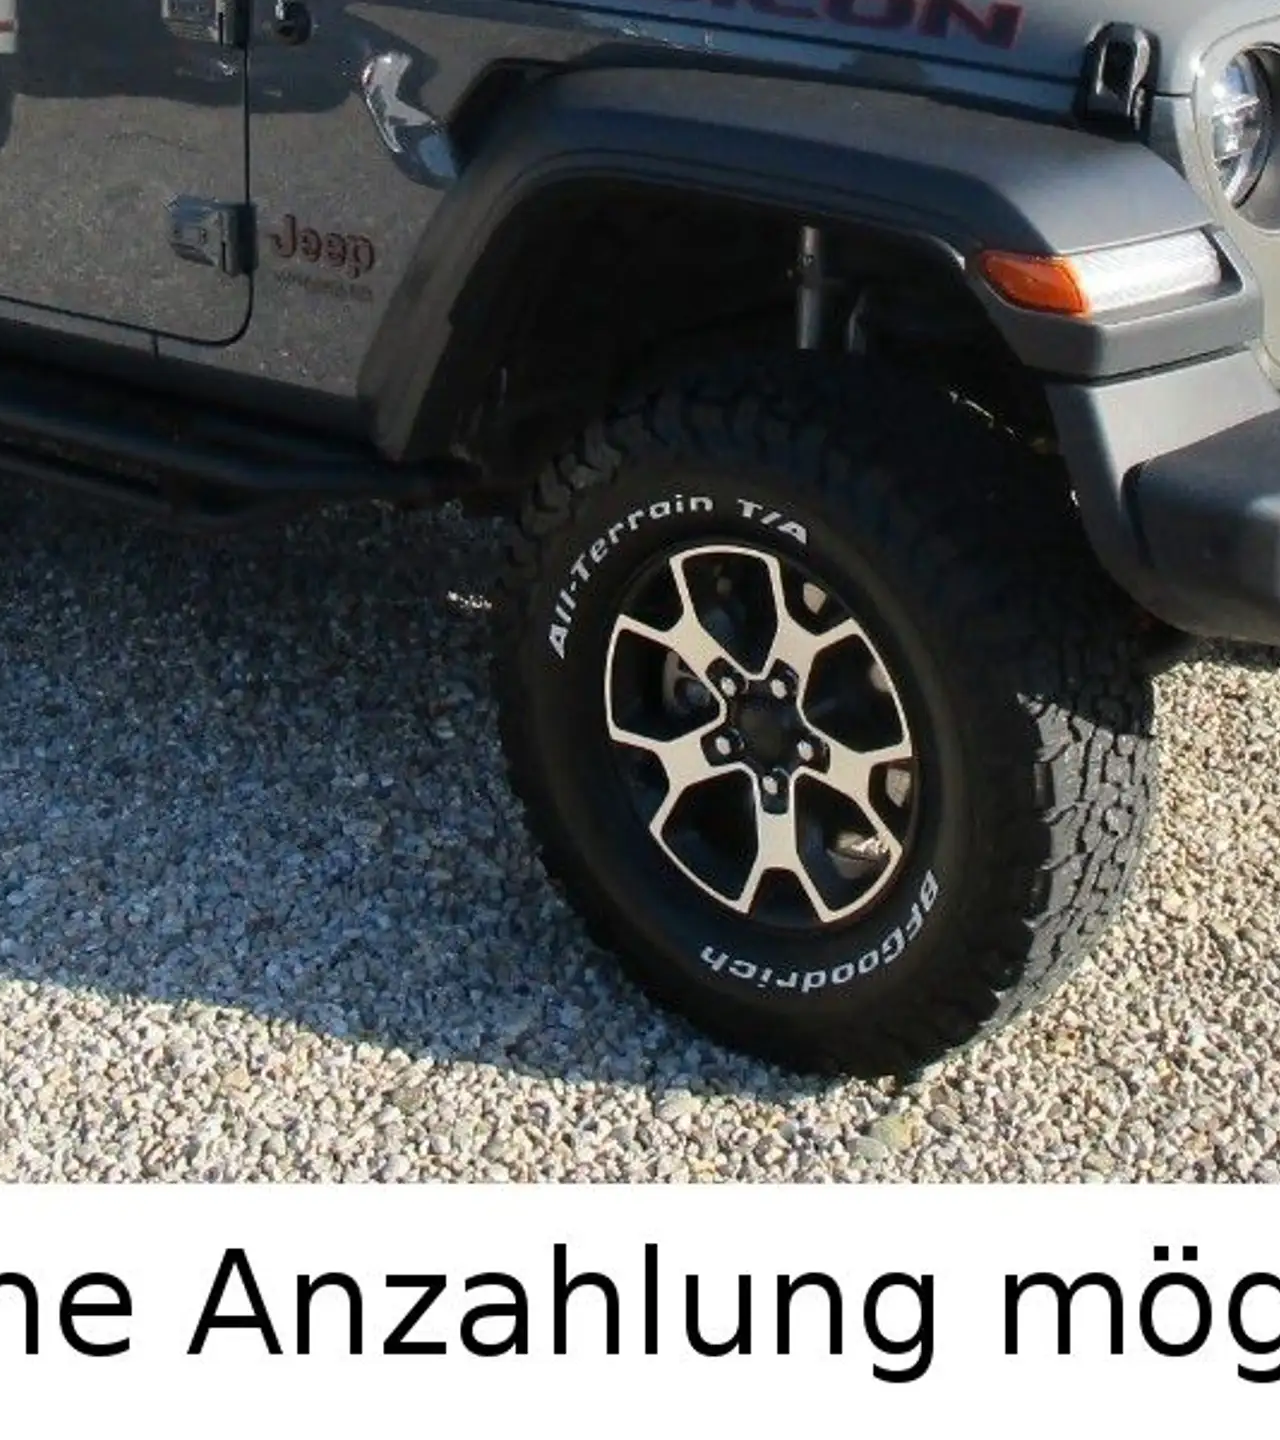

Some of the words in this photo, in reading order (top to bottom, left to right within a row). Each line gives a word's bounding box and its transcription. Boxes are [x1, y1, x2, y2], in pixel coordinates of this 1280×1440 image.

[269, 213, 375, 280] Jeep
[548, 494, 714, 659] All-Terrain
[736, 499, 809, 548] T/A
[701, 869, 939, 992] BFGoodrich
